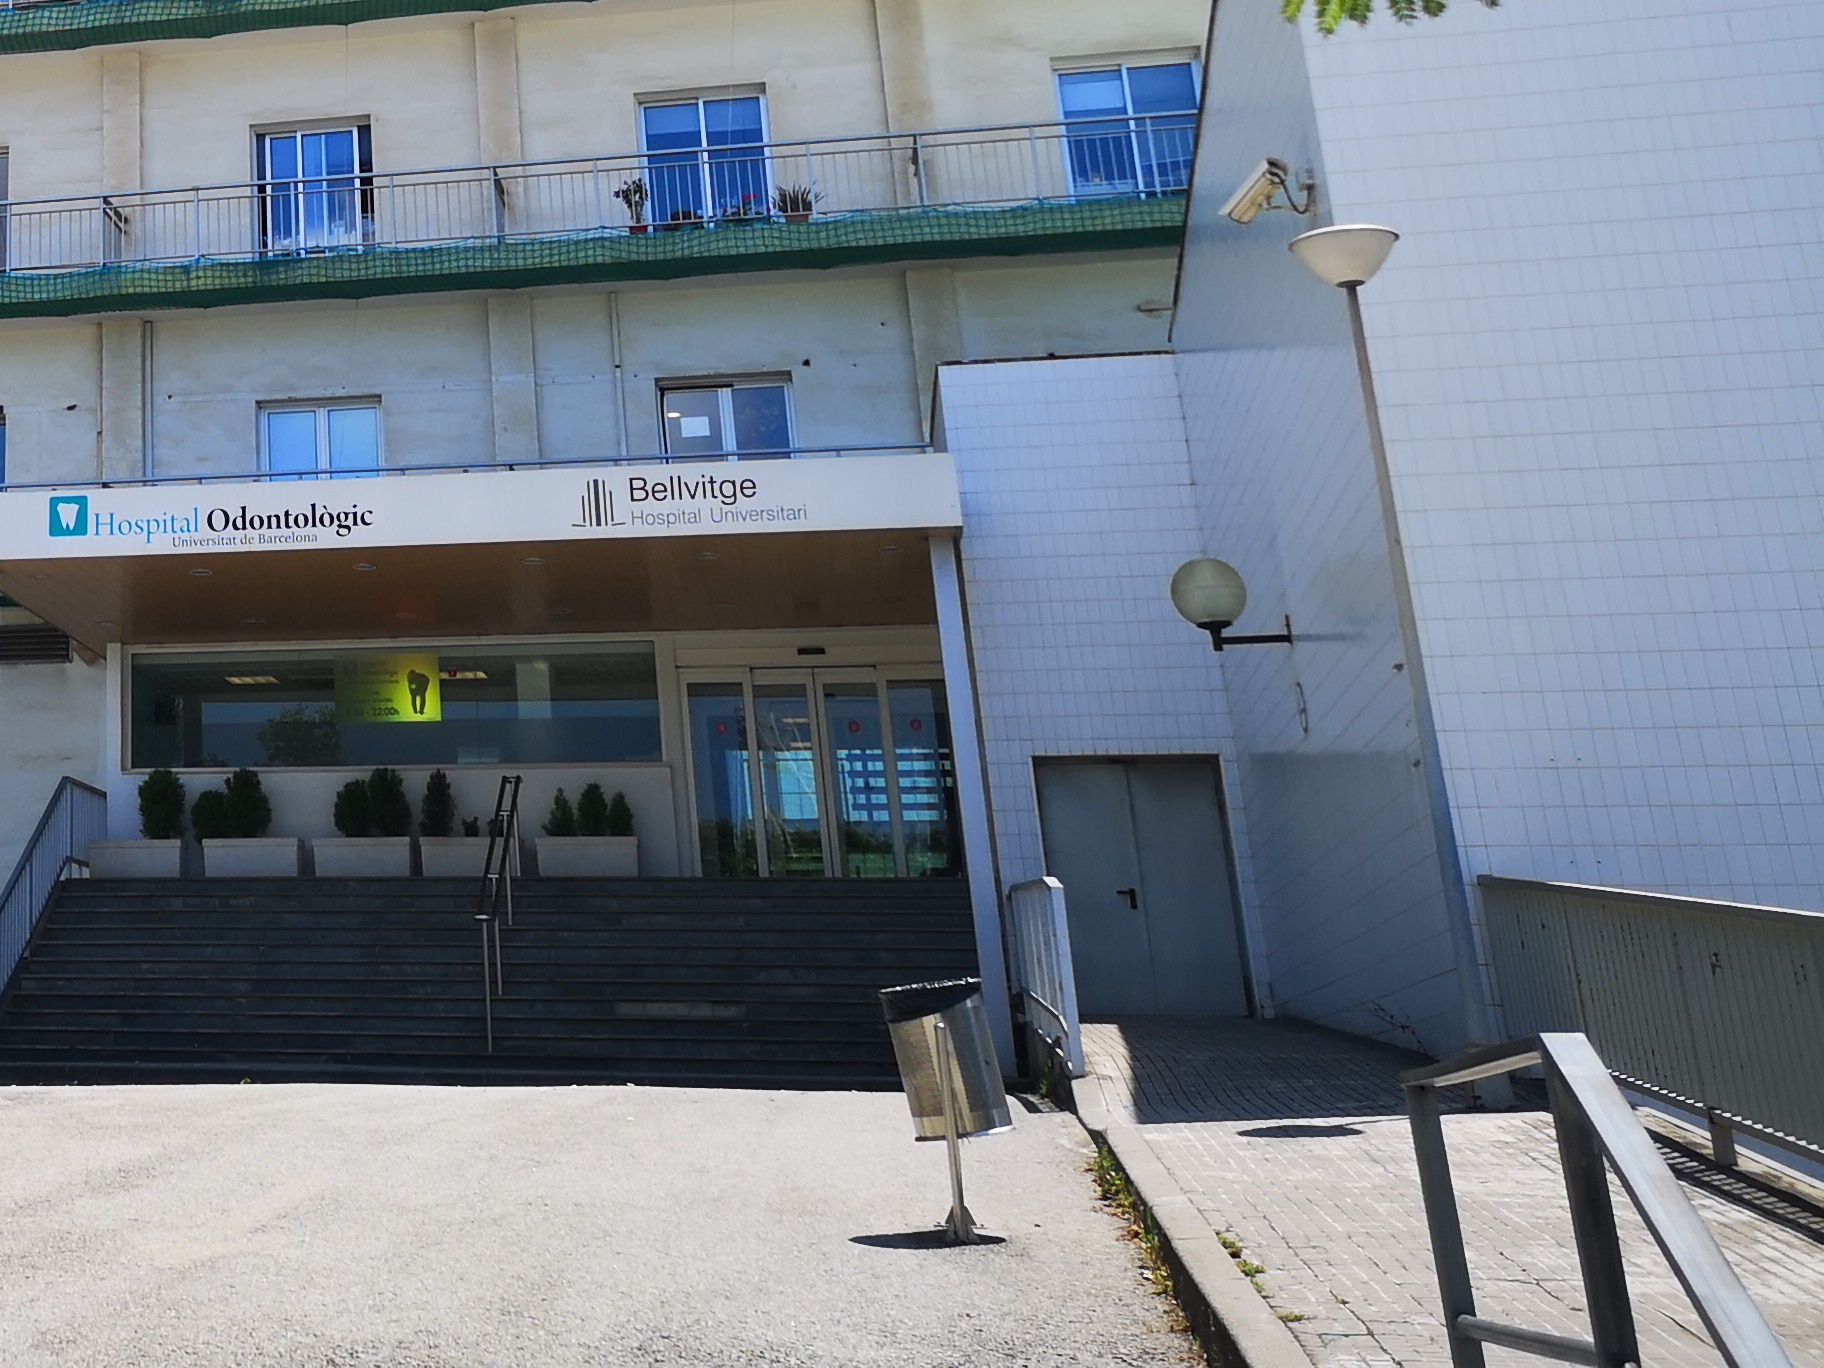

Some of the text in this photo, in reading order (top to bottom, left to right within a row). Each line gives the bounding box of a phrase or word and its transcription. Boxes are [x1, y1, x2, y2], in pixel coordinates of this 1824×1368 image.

[629, 474, 757, 506] Bellvitge
[94, 502, 374, 544] Hospital Odontològic
[631, 504, 808, 529] Hospital Universitari
[172, 532, 318, 548] Universitat de Barcelona
